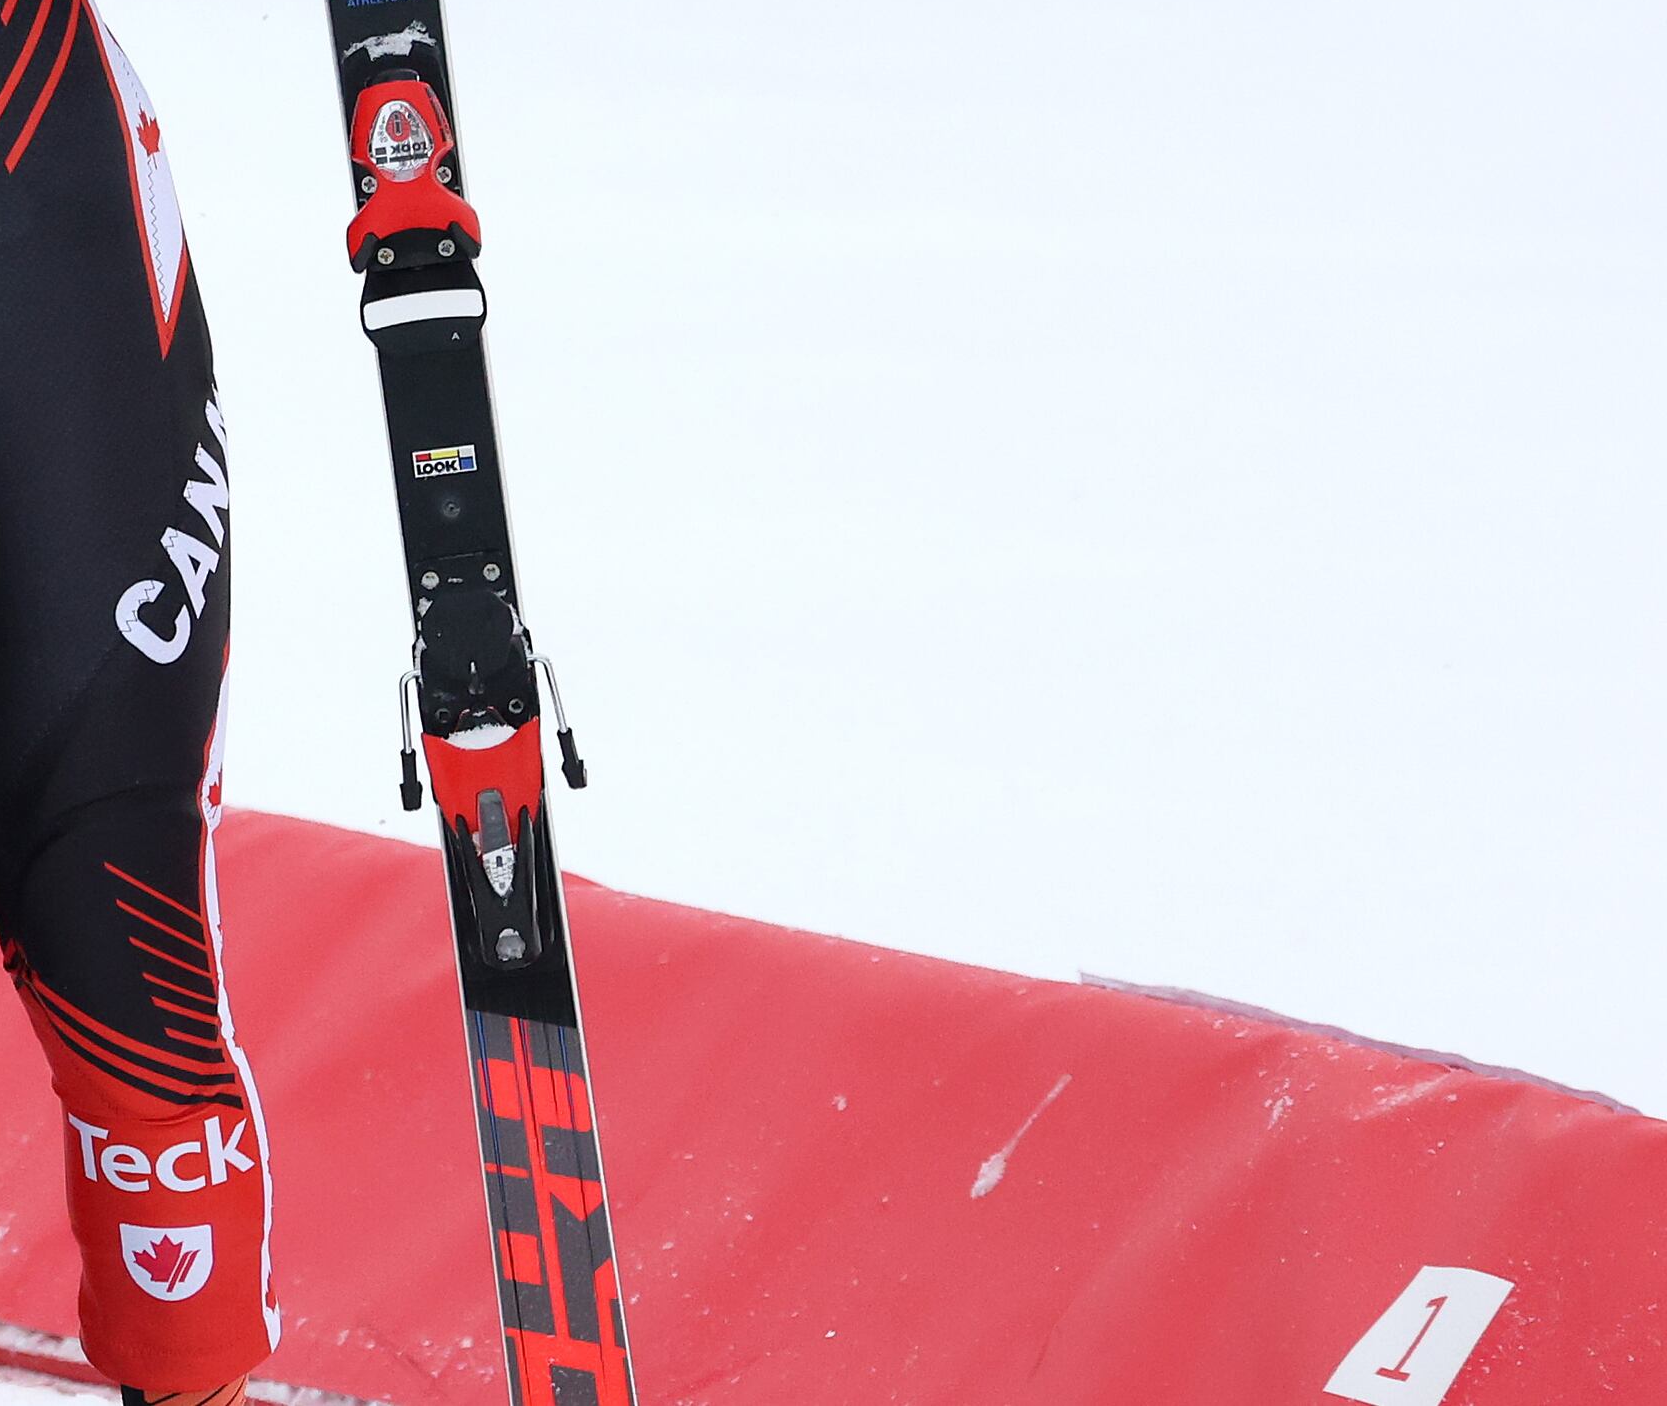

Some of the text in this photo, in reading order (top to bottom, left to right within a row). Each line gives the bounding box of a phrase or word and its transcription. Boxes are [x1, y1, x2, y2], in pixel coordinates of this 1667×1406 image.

[415, 457, 459, 477] LOOK
[67, 1112, 255, 1194] Teck
[1375, 1295, 1448, 1382] 1
